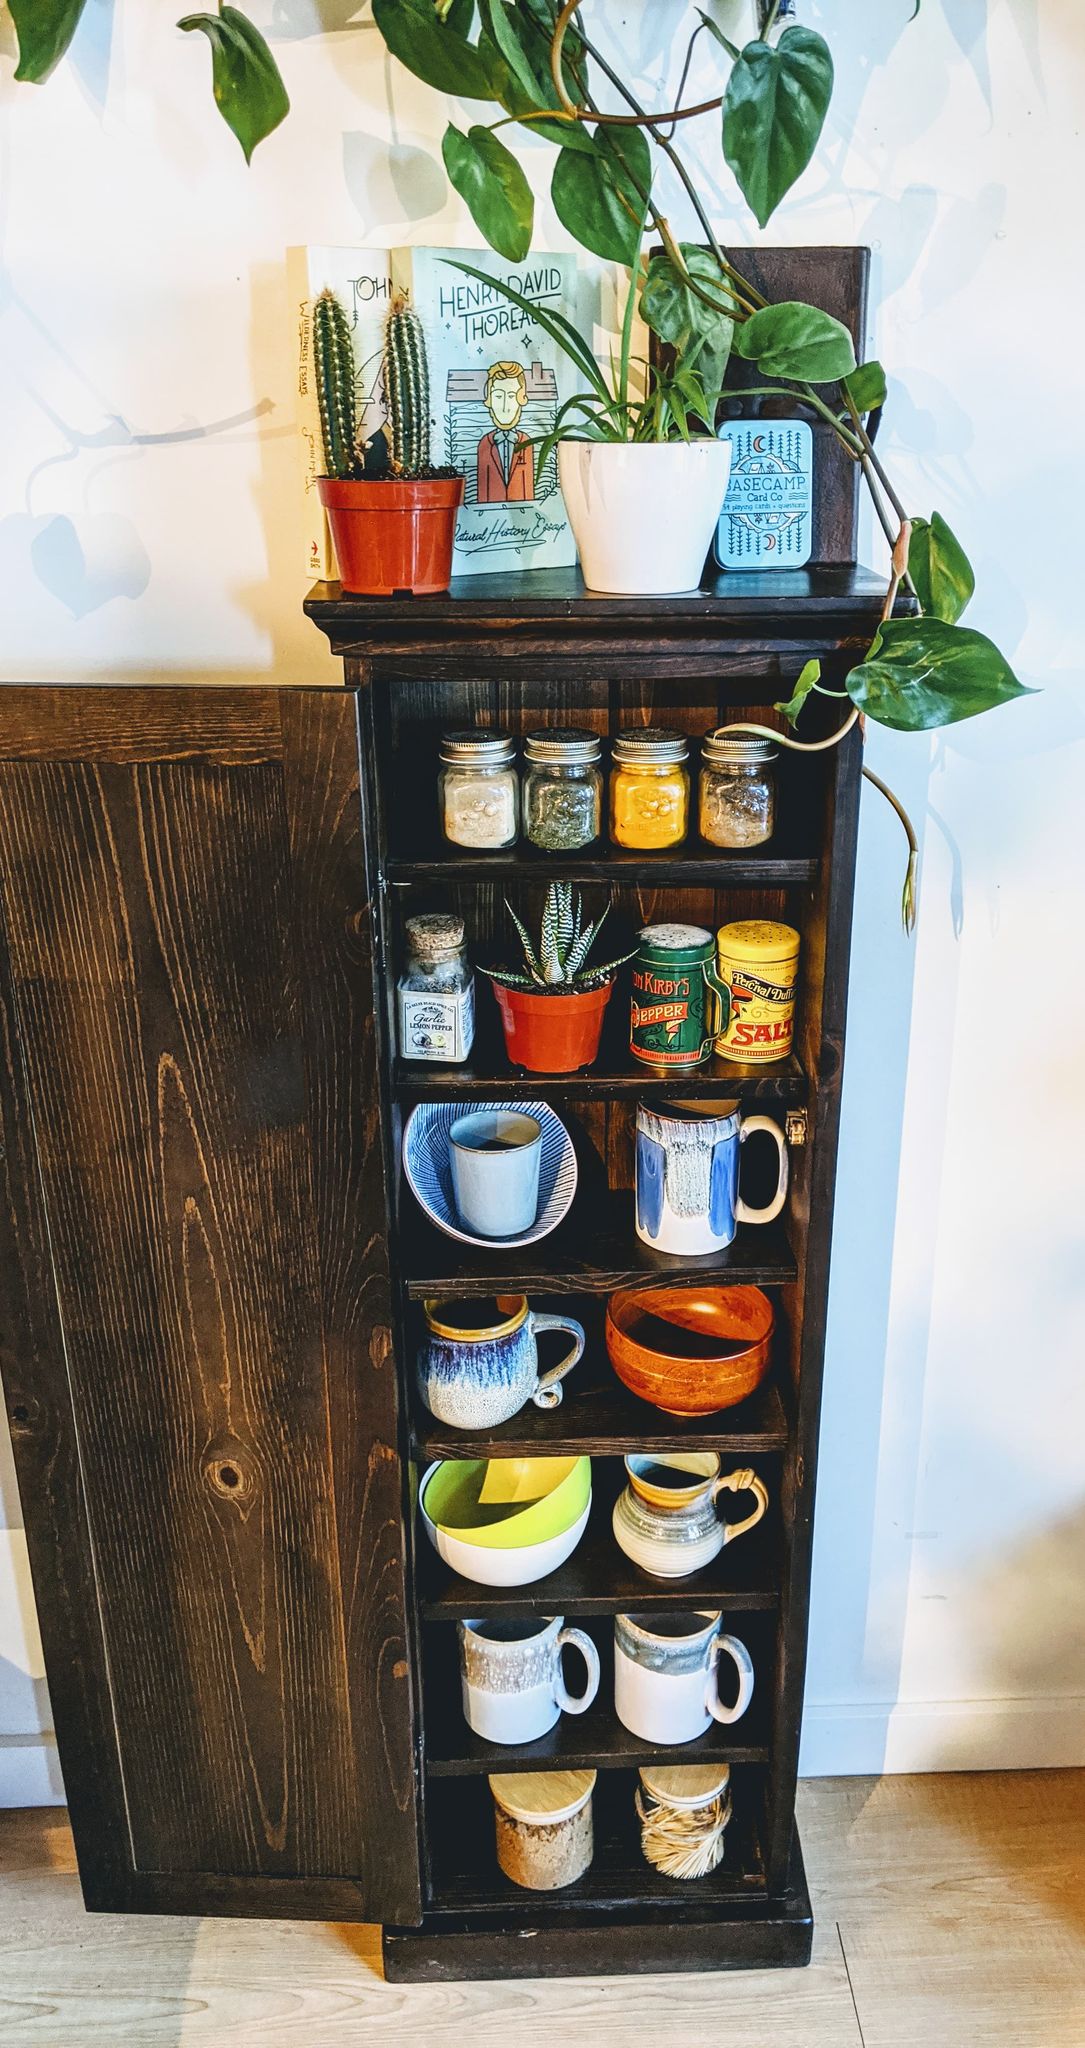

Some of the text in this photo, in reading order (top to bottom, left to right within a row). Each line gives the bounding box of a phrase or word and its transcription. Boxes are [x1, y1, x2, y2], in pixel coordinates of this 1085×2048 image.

[507, 268, 562, 302] DAVID
[299, 301, 310, 397] WILDERNESS ESSAYS
[732, 503, 753, 511] playing
[747, 492, 783, 502] Card Co
[485, 518, 530, 544] History
[644, 971, 690, 996] KIRBY'S
[733, 972, 772, 999] Percival
[409, 1022, 453, 1032] LEMON PEPPER
[413, 1011, 446, 1024] Garlic
[731, 1019, 792, 1046] SALT
